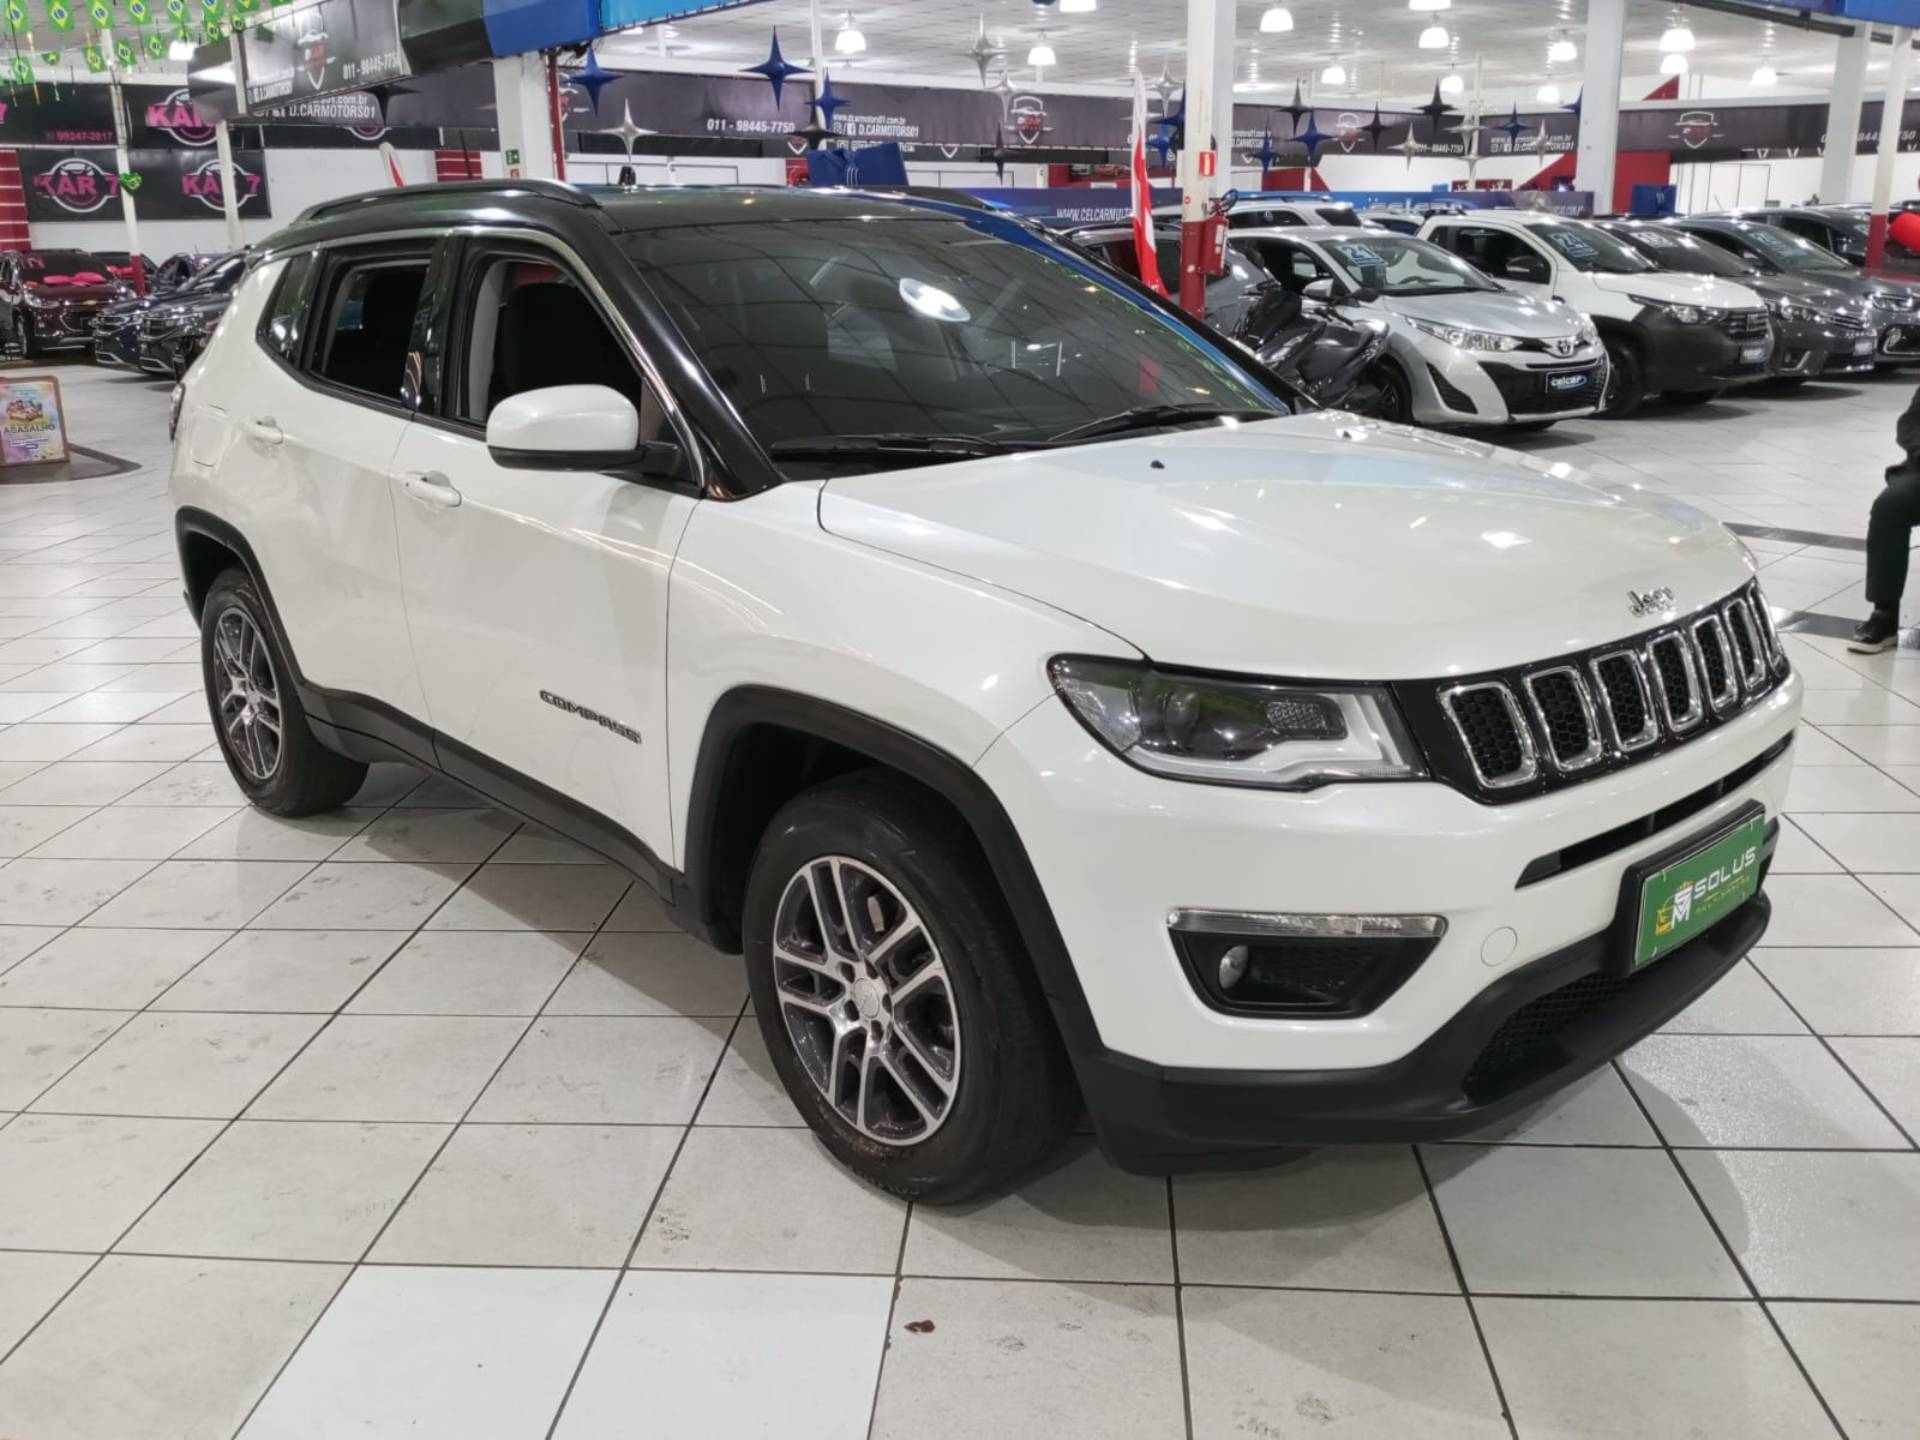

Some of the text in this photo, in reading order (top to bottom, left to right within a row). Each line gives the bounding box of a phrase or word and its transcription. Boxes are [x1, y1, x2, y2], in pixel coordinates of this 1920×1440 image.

[707, 119, 726, 131] 011
[736, 120, 796, 133] 98445-7750
[34, 175, 119, 195] KAR 7
[246, 175, 261, 194] 7
[539, 690, 642, 744] COMPASS
[1694, 846, 1757, 899] SOLUS
